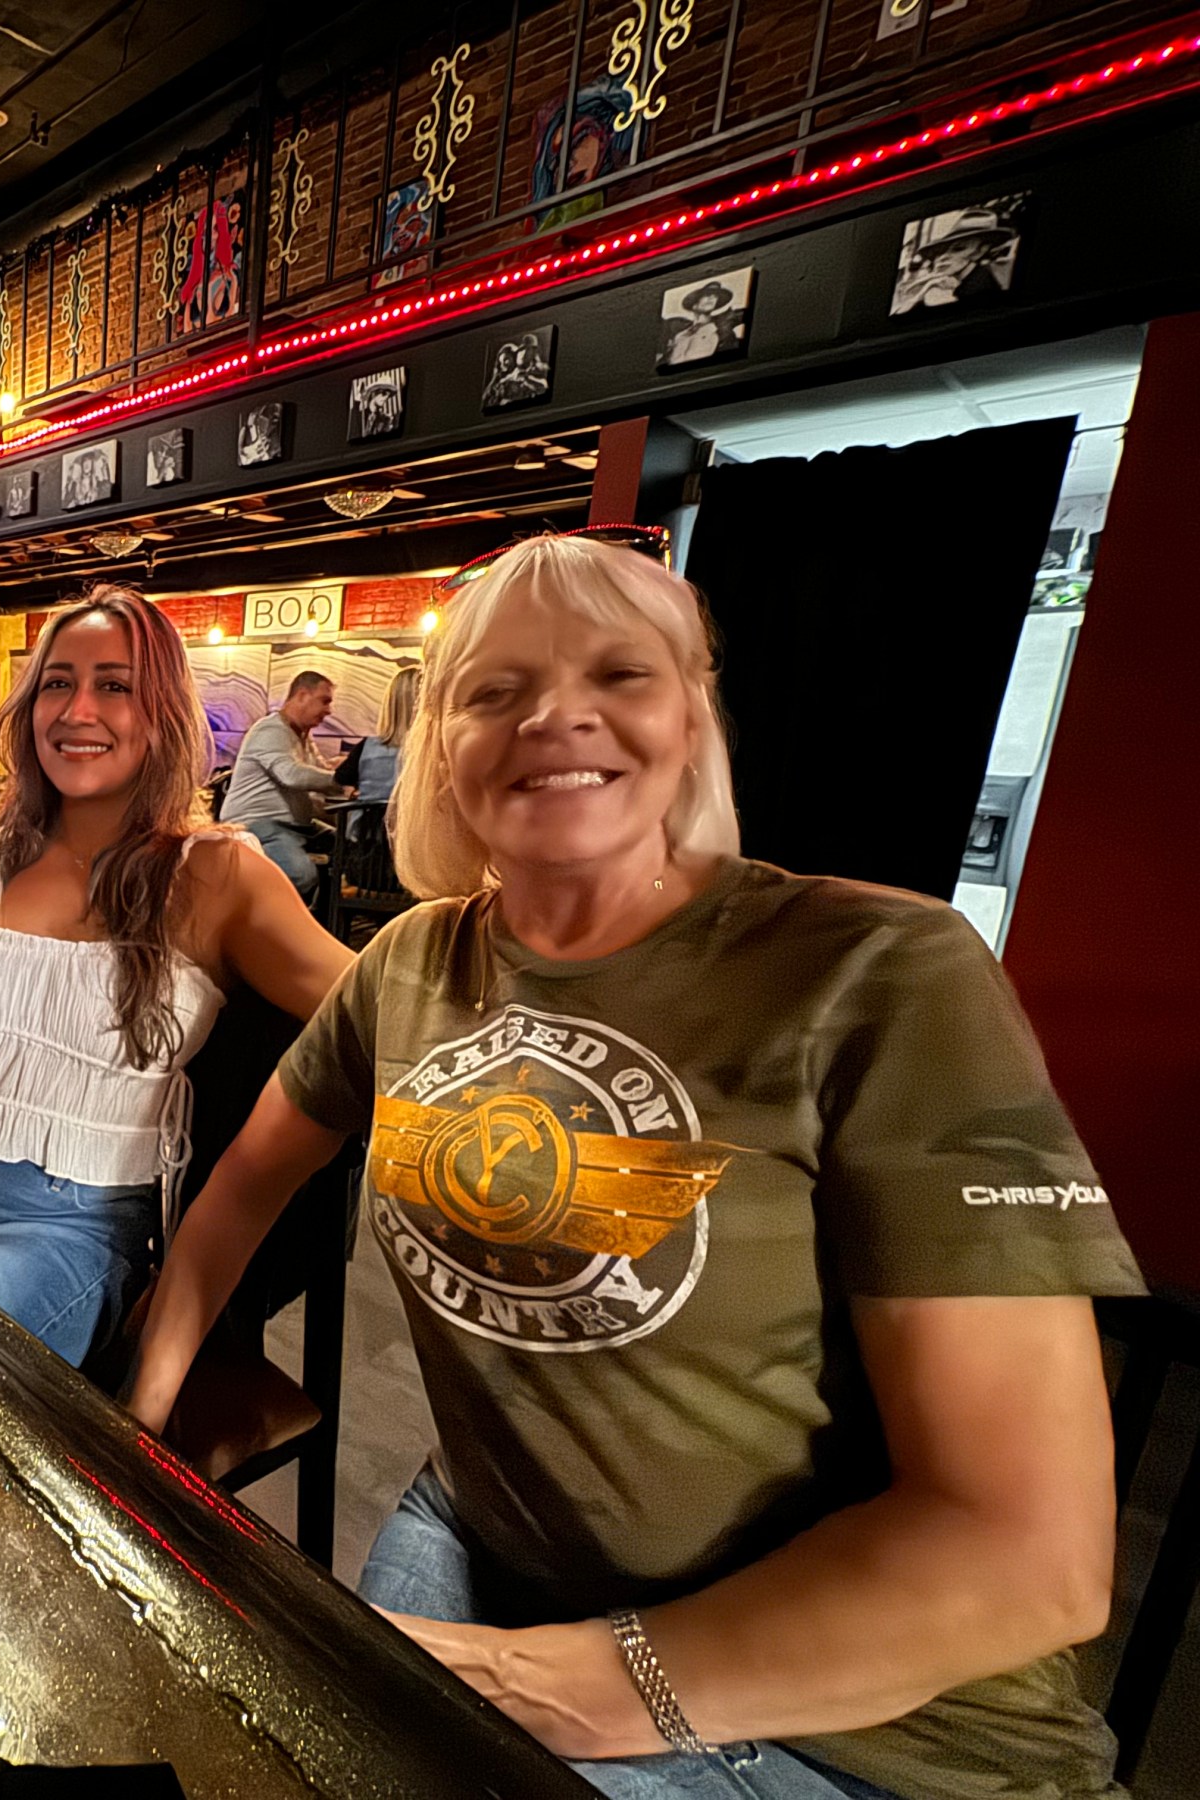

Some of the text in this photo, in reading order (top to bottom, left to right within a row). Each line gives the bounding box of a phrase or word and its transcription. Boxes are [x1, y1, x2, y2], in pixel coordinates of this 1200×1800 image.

[253, 594, 332, 629] BOO
[409, 1014, 678, 1133] RAISED ON
[374, 1196, 664, 1338] COUNTRY
